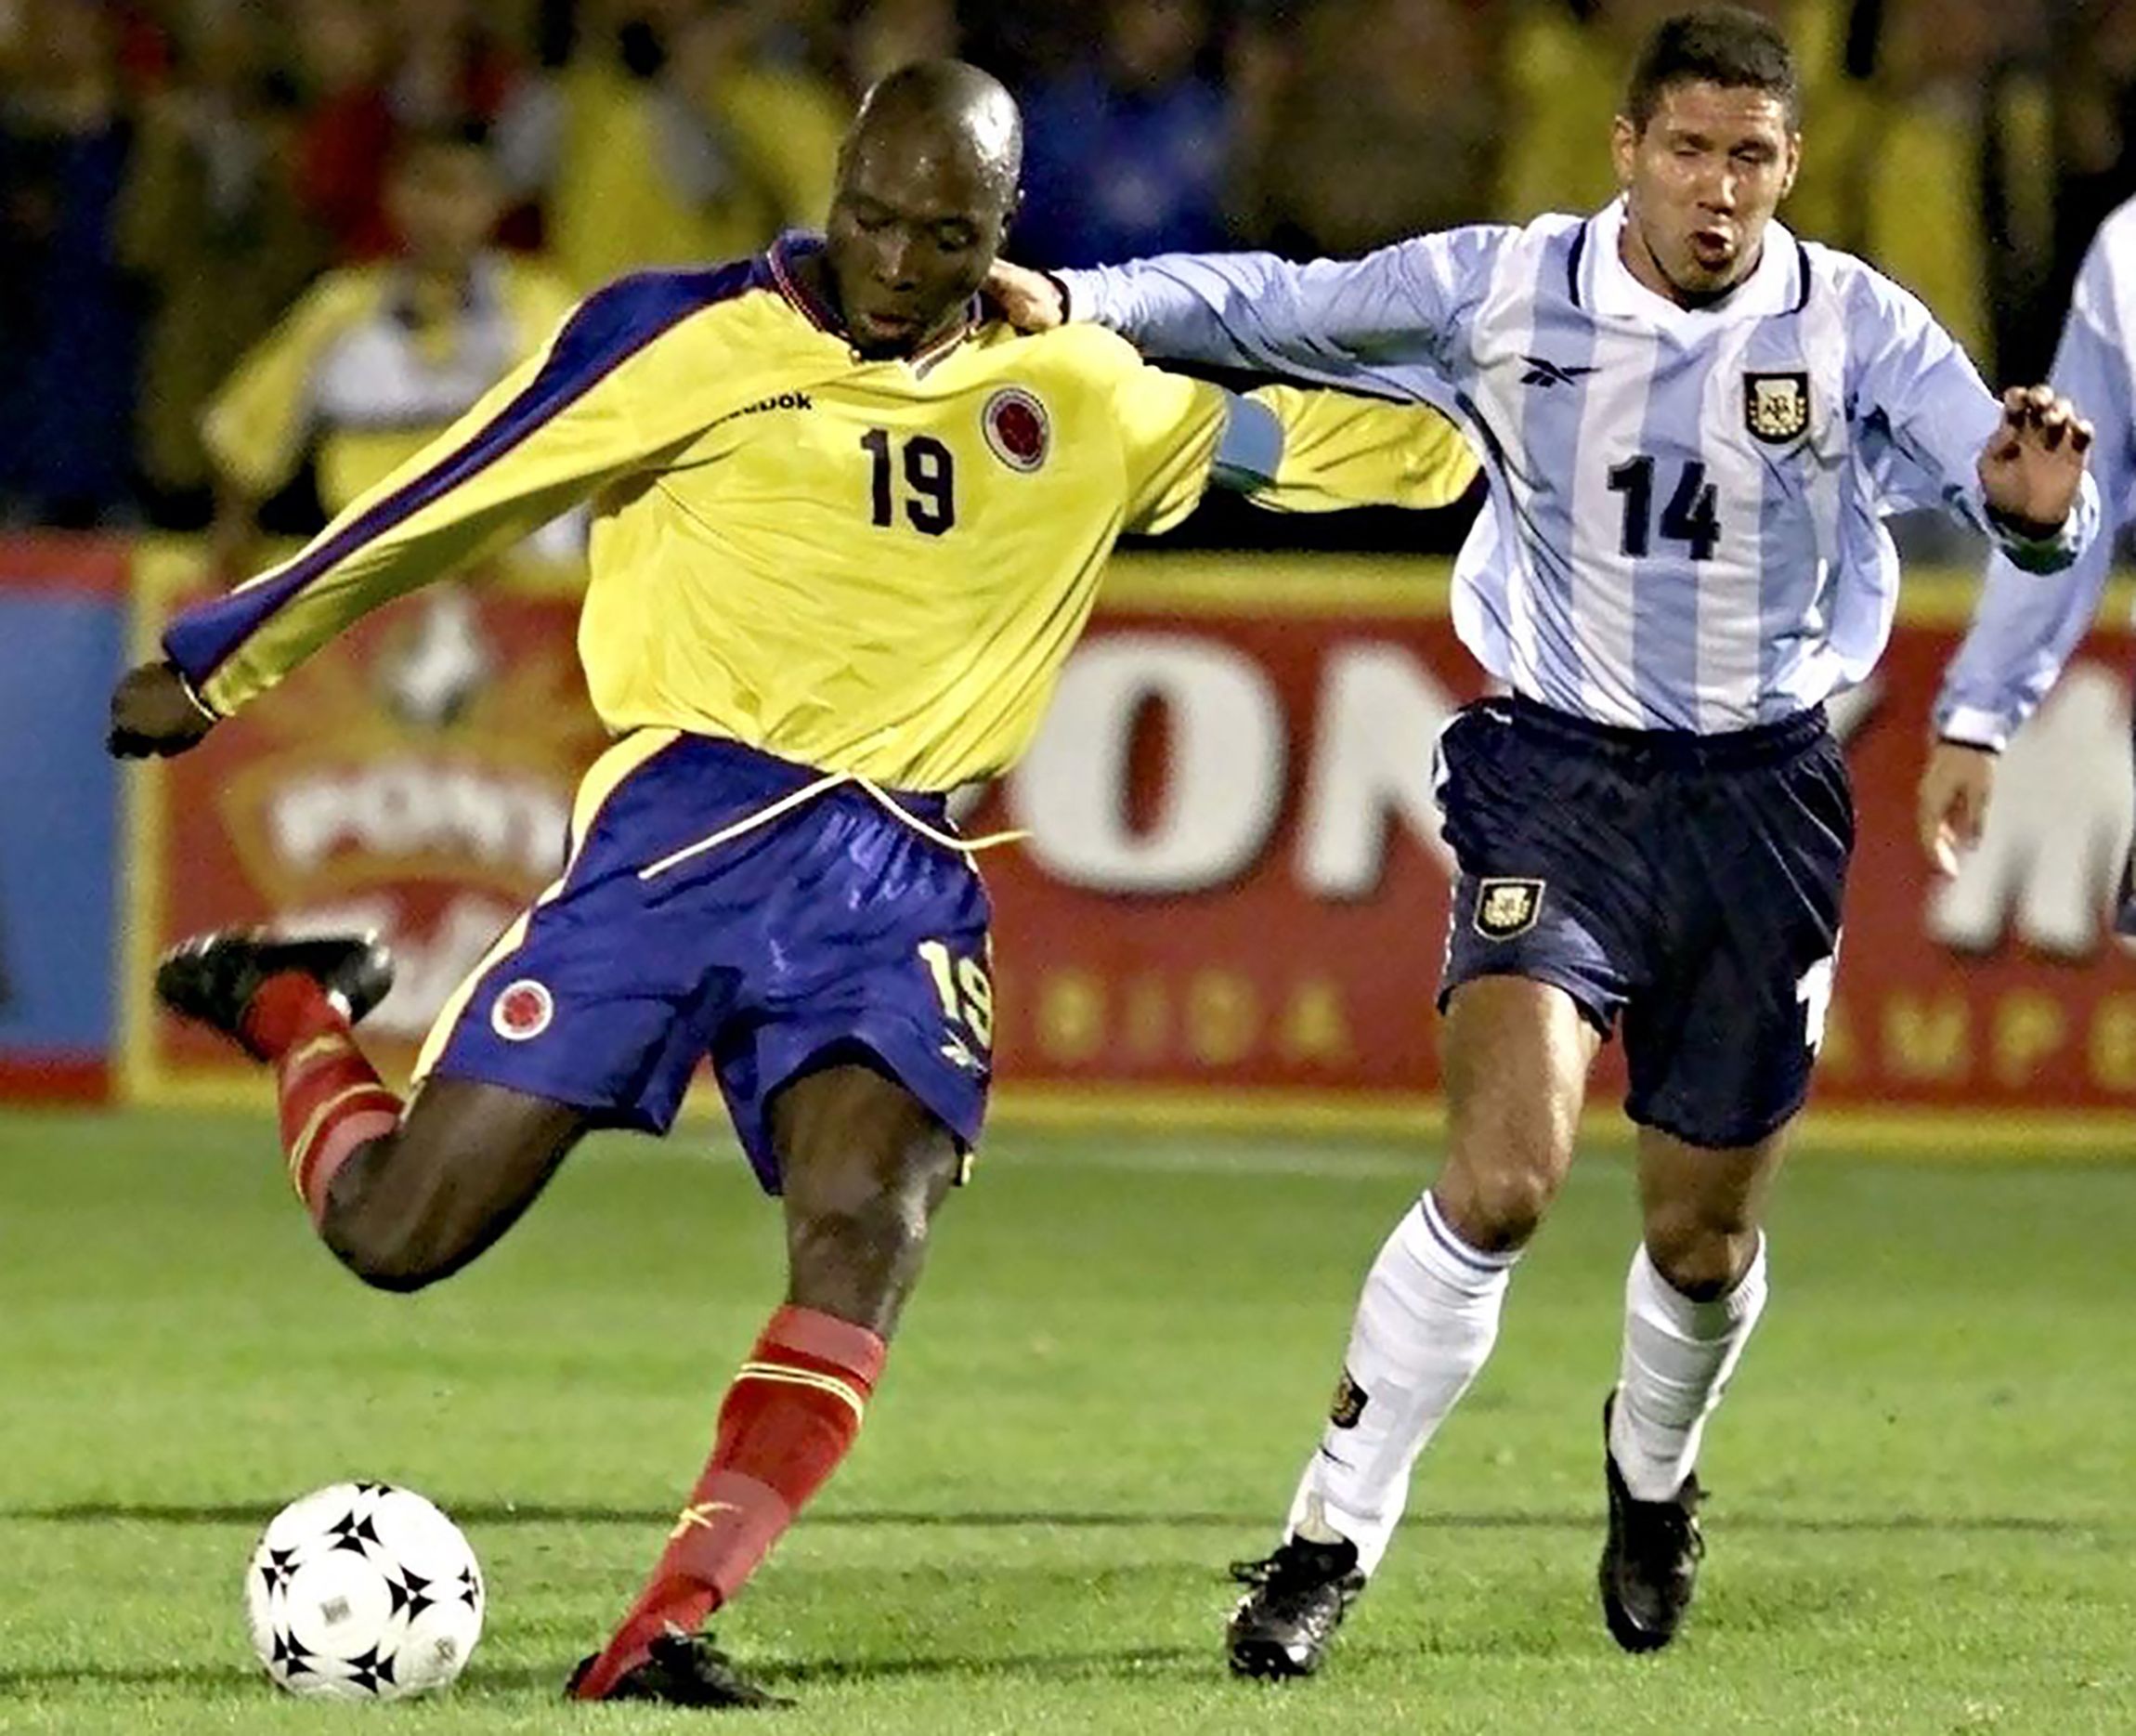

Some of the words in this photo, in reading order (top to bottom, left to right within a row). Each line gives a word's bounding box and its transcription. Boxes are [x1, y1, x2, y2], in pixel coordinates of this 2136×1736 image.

[860, 428, 955, 536] 19
[1607, 454, 1721, 560] 14
[918, 940, 994, 1051] 19
[1795, 955, 1835, 1058] 1
